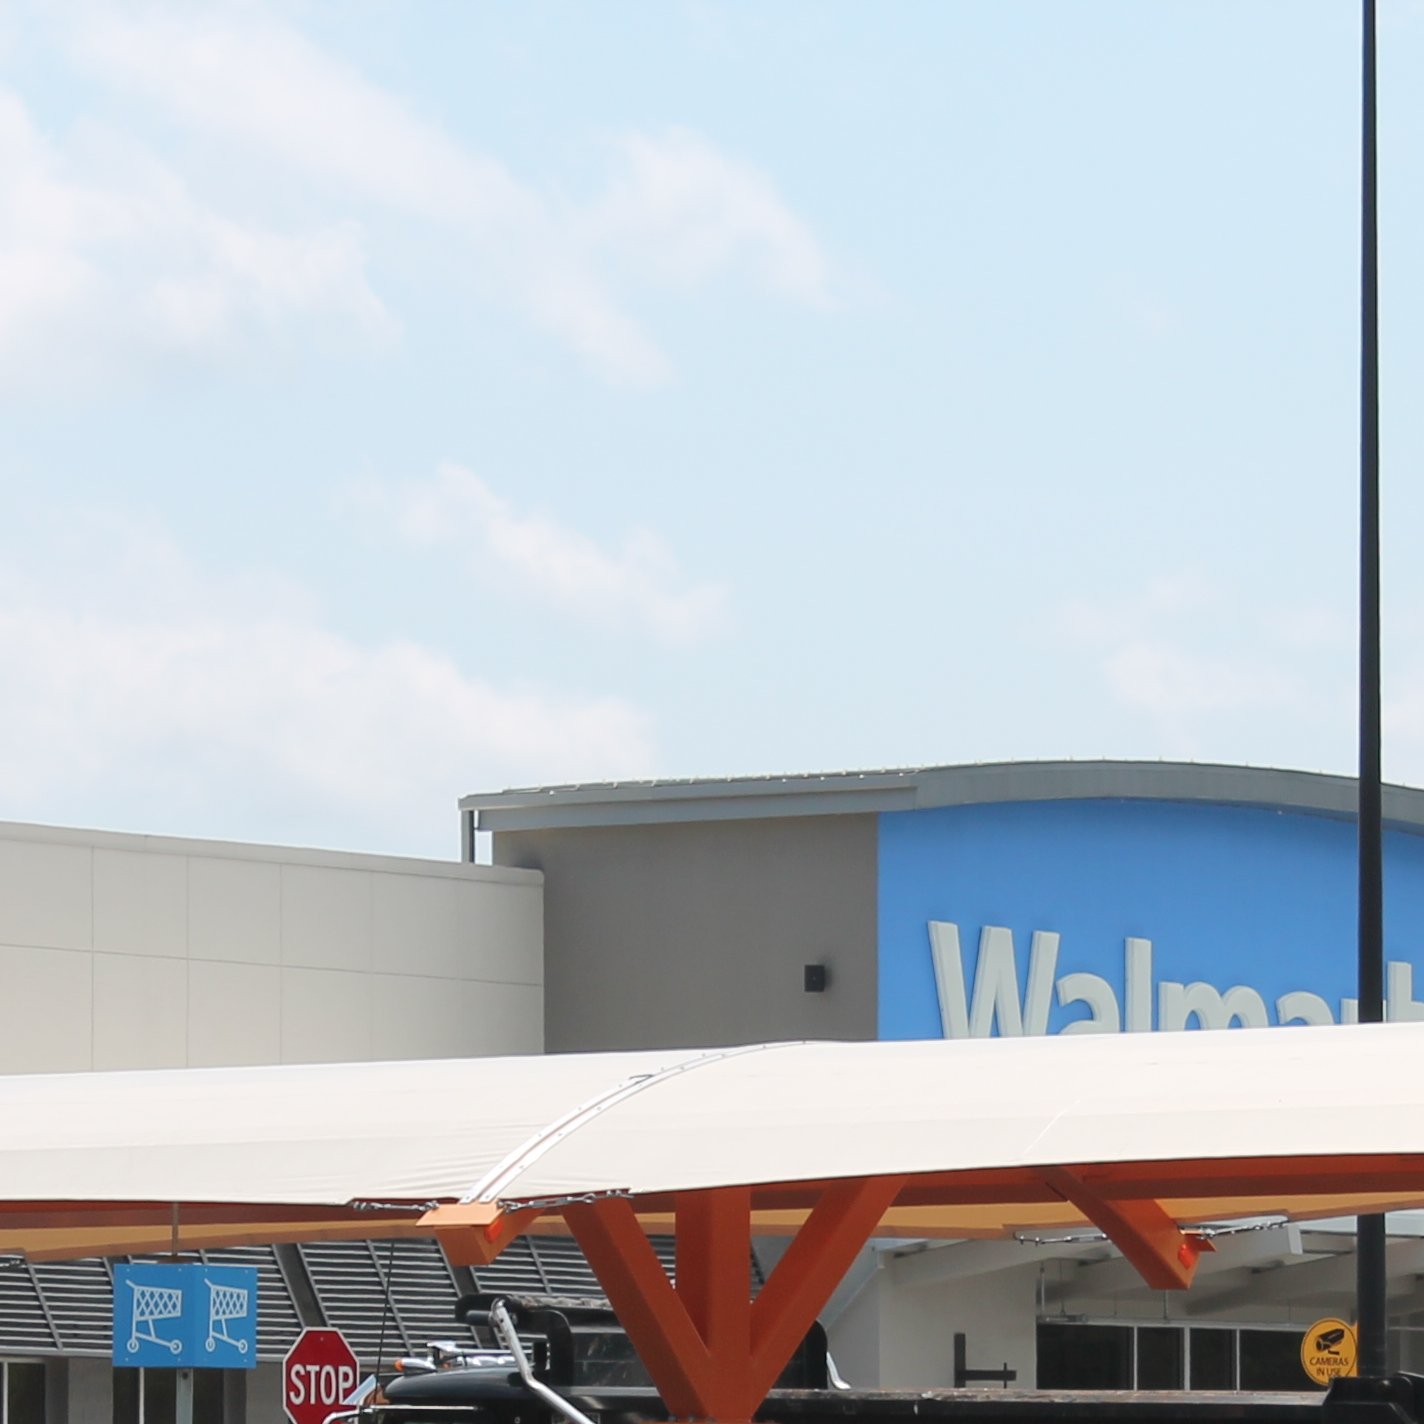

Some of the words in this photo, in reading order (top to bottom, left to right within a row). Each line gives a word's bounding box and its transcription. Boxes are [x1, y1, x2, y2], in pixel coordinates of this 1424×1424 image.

[1309, 1357, 1349, 1366] CAMERAS
[1316, 1368, 1325, 1376] IN
[1327, 1368, 1341, 1377] USE
[289, 1364, 356, 1406] STOP
